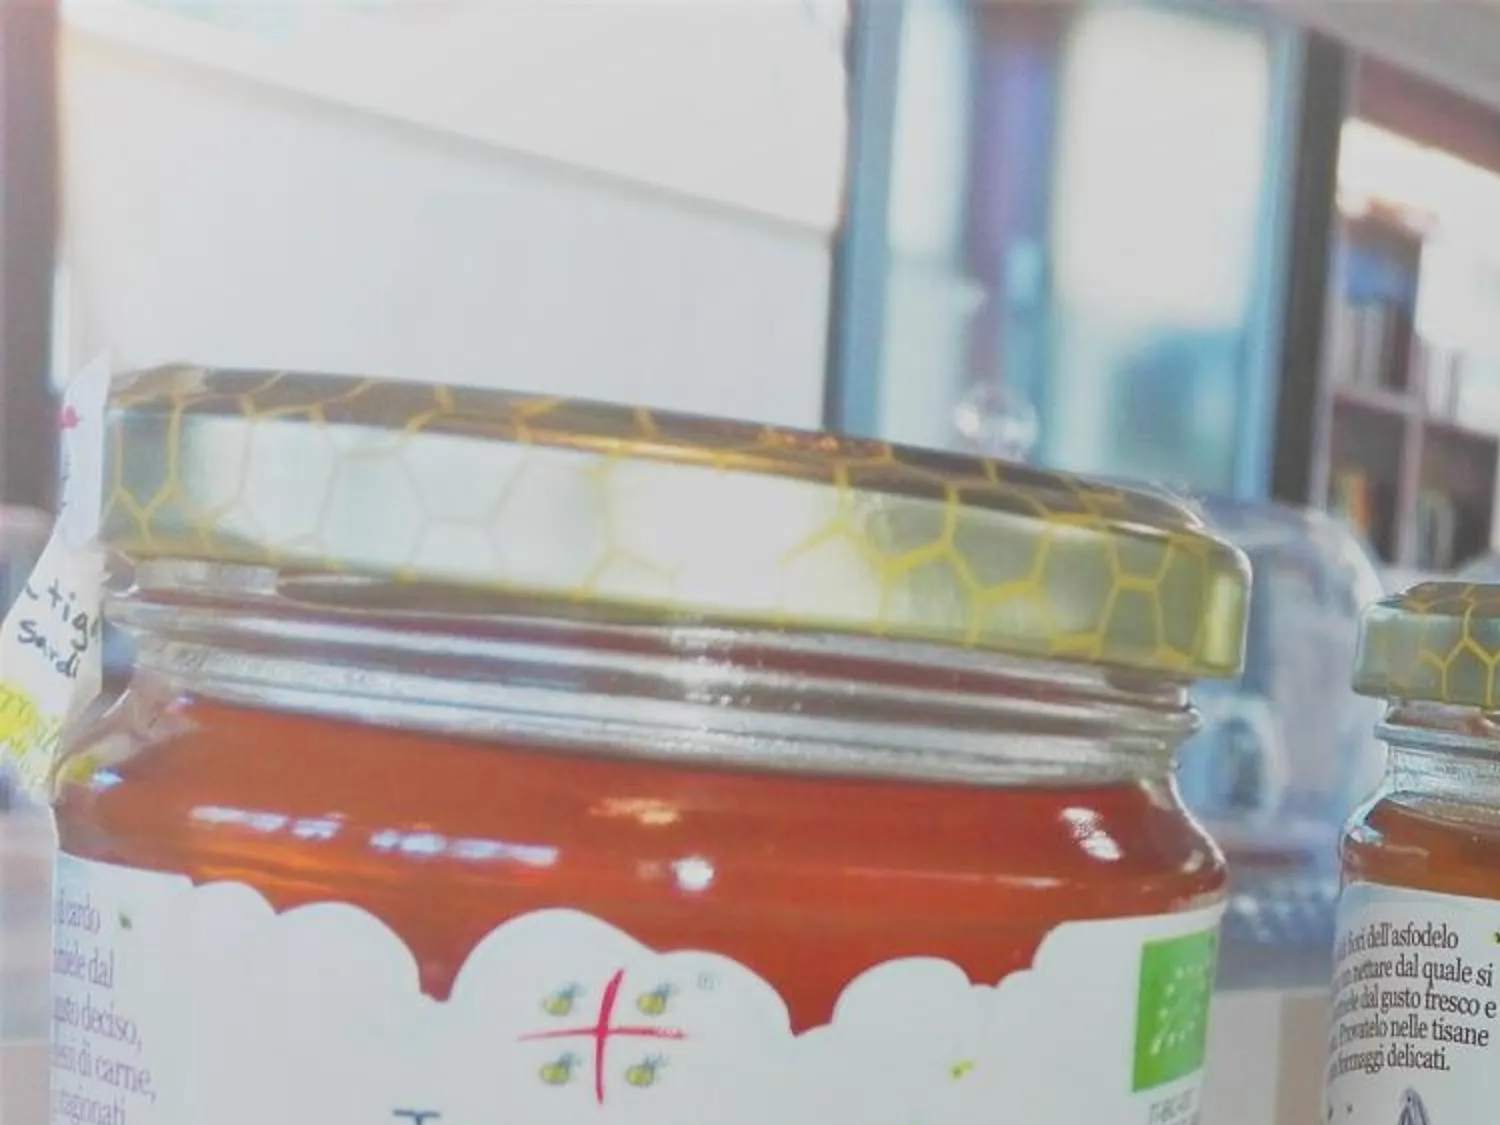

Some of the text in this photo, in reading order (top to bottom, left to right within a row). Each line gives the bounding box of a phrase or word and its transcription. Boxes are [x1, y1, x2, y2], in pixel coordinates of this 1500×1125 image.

[17, 620, 80, 679] Sardi
[1367, 920, 1459, 949] dell'asfodelo
[88, 947, 114, 988] dal
[1395, 953, 1419, 978] dal
[1422, 957, 1473, 990] quale
[1476, 962, 1494, 988] si
[1381, 987, 1421, 1014] gusto
[1424, 986, 1481, 1017] fresco
[1484, 1000, 1498, 1019] e
[81, 992, 143, 1052] deciso,
[1390, 1013, 1428, 1040] nelle
[1431, 1016, 1490, 1047] tisane
[1387, 1042, 1451, 1072] delicati.
[95, 1054, 157, 1104] carne,
